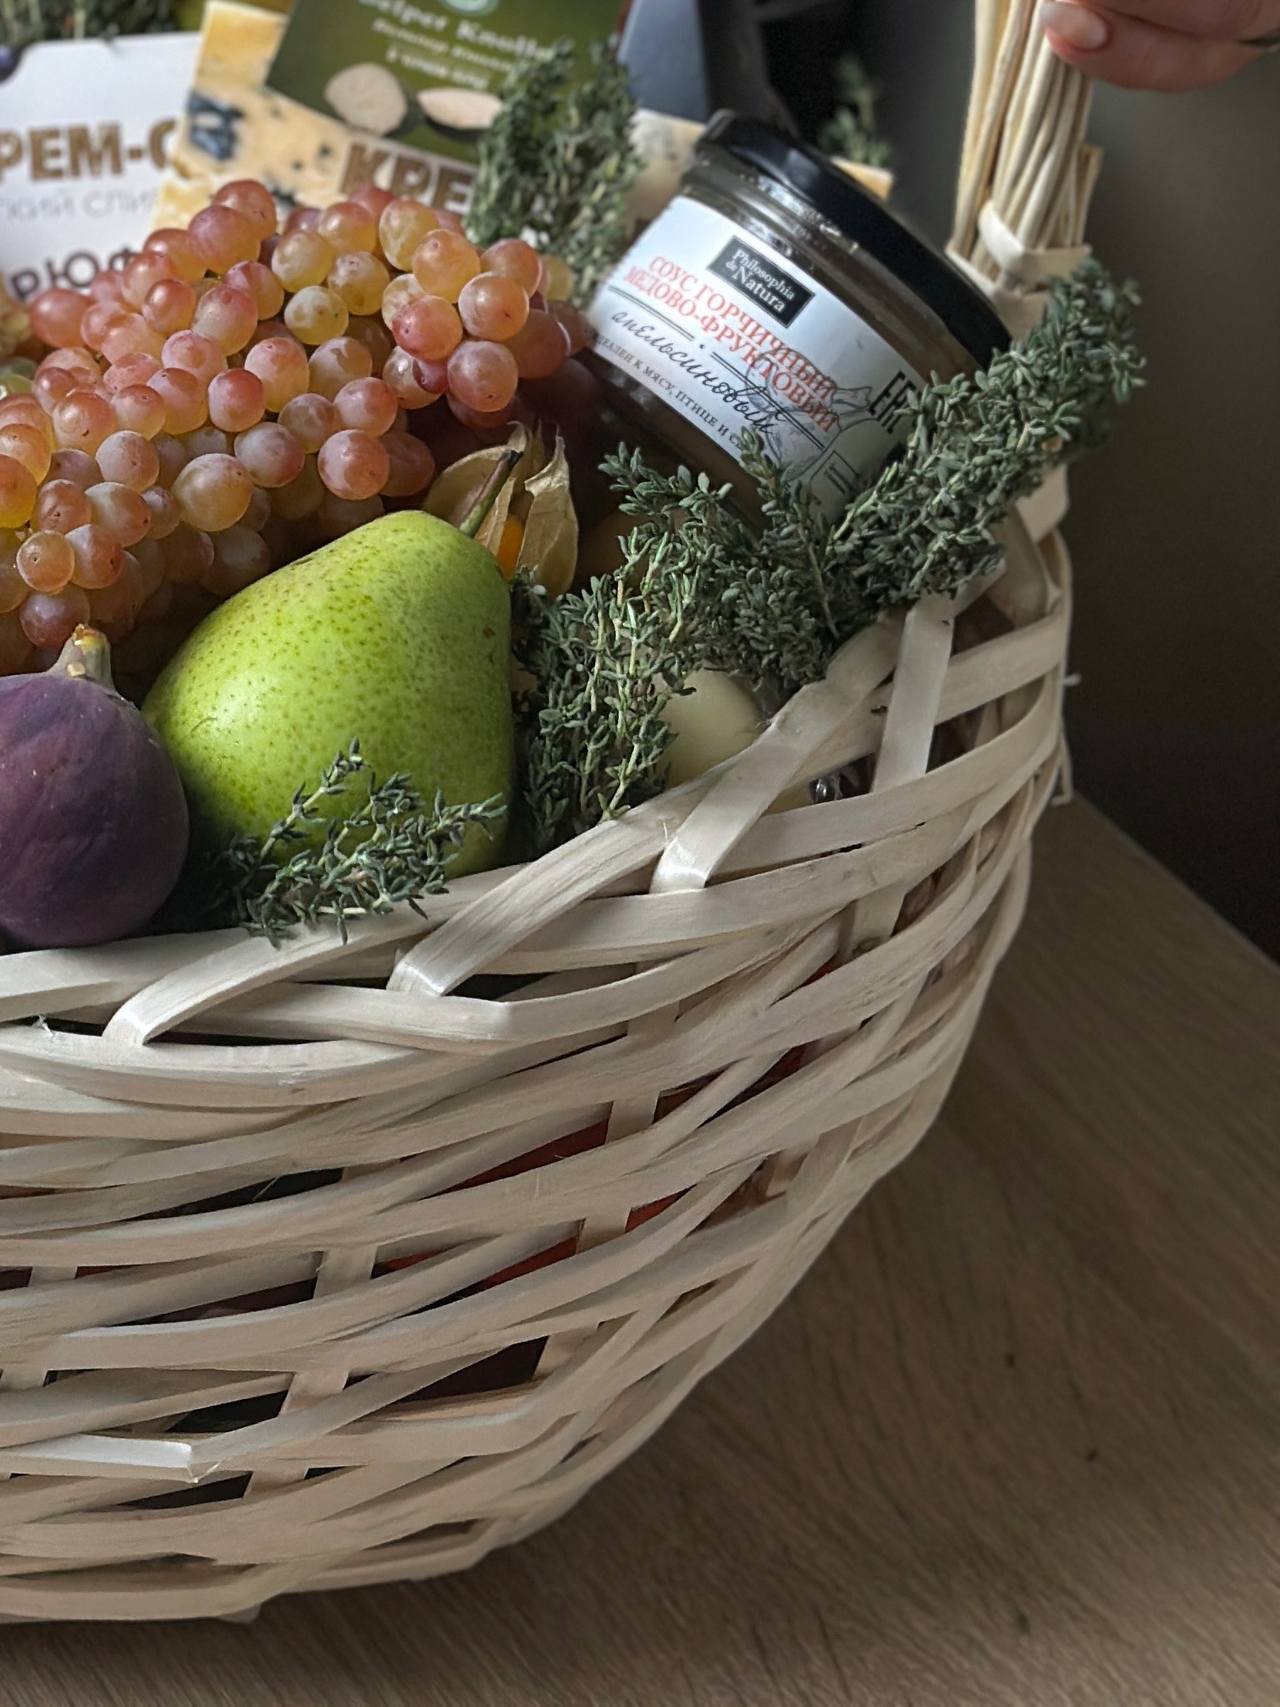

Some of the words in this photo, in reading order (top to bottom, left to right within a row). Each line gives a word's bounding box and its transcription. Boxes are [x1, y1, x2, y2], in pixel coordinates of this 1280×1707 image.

[731, 266, 786, 312] Natura
[732, 248, 795, 301] Philosophia
[623, 266, 838, 433] МЕДОВО-ФРУКТОВЫЙ
[648, 256, 694, 293] СОУС
[694, 282, 837, 401] ГОРЧИЧНЫЙ
[611, 311, 787, 435] апельсиновый
[675, 390, 718, 427] ПТИЦЕ
[717, 424, 730, 437] И
